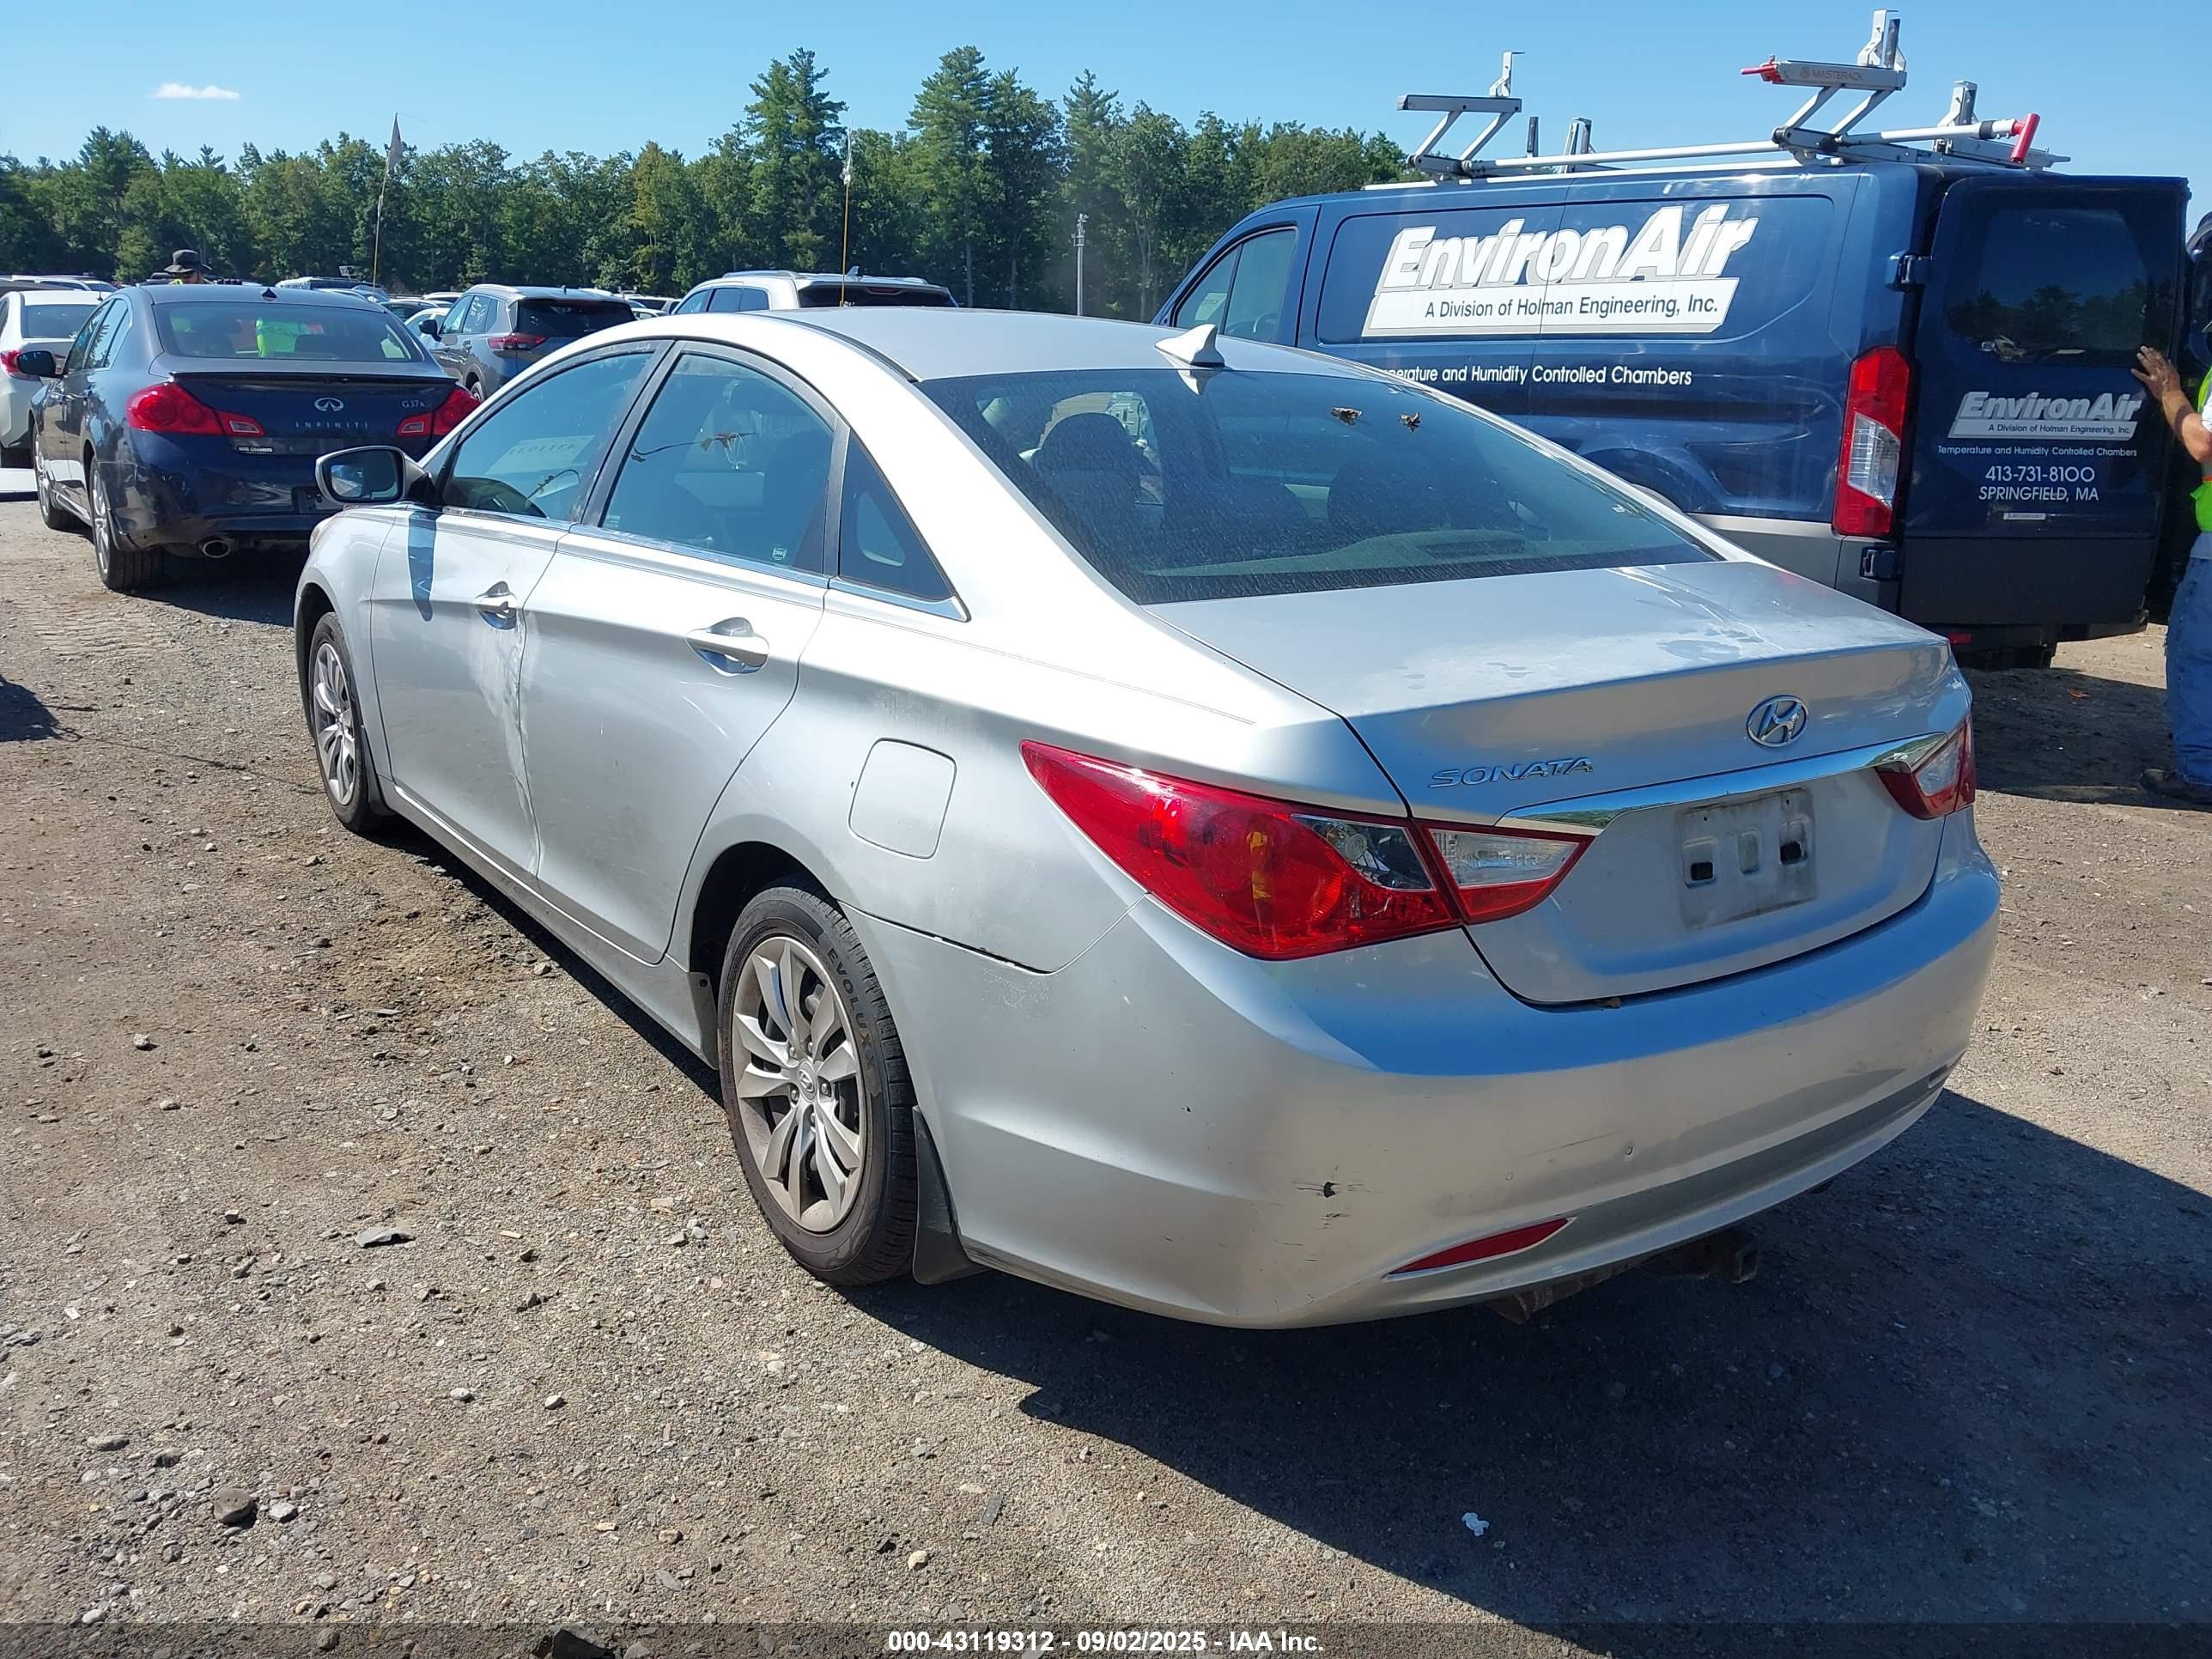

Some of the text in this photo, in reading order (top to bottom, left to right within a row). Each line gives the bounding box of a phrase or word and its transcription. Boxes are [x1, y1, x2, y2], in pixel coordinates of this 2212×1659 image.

[1377, 204, 1759, 292] EnvironAir
[1425, 294, 1718, 319] A Division of Holman Engineering, Inc.
[1442, 366, 1468, 381] and
[1471, 366, 1528, 386] Humidity
[1532, 365, 1607, 383] Controlled
[1611, 366, 1692, 386] Chambers
[1957, 392, 2142, 421] EnvironAir
[2039, 424, 2069, 433] Holman
[1937, 446, 1992, 455] Temperature
[2014, 447, 2049, 457] Humidity
[2051, 447, 2094, 456] Controlled
[2096, 447, 2137, 458] Chambers
[1985, 465, 2095, 482] 413-731-8100
[1978, 486, 2099, 502] SPRINGFIELD, MA
[1429, 757, 1594, 788] SONATA
